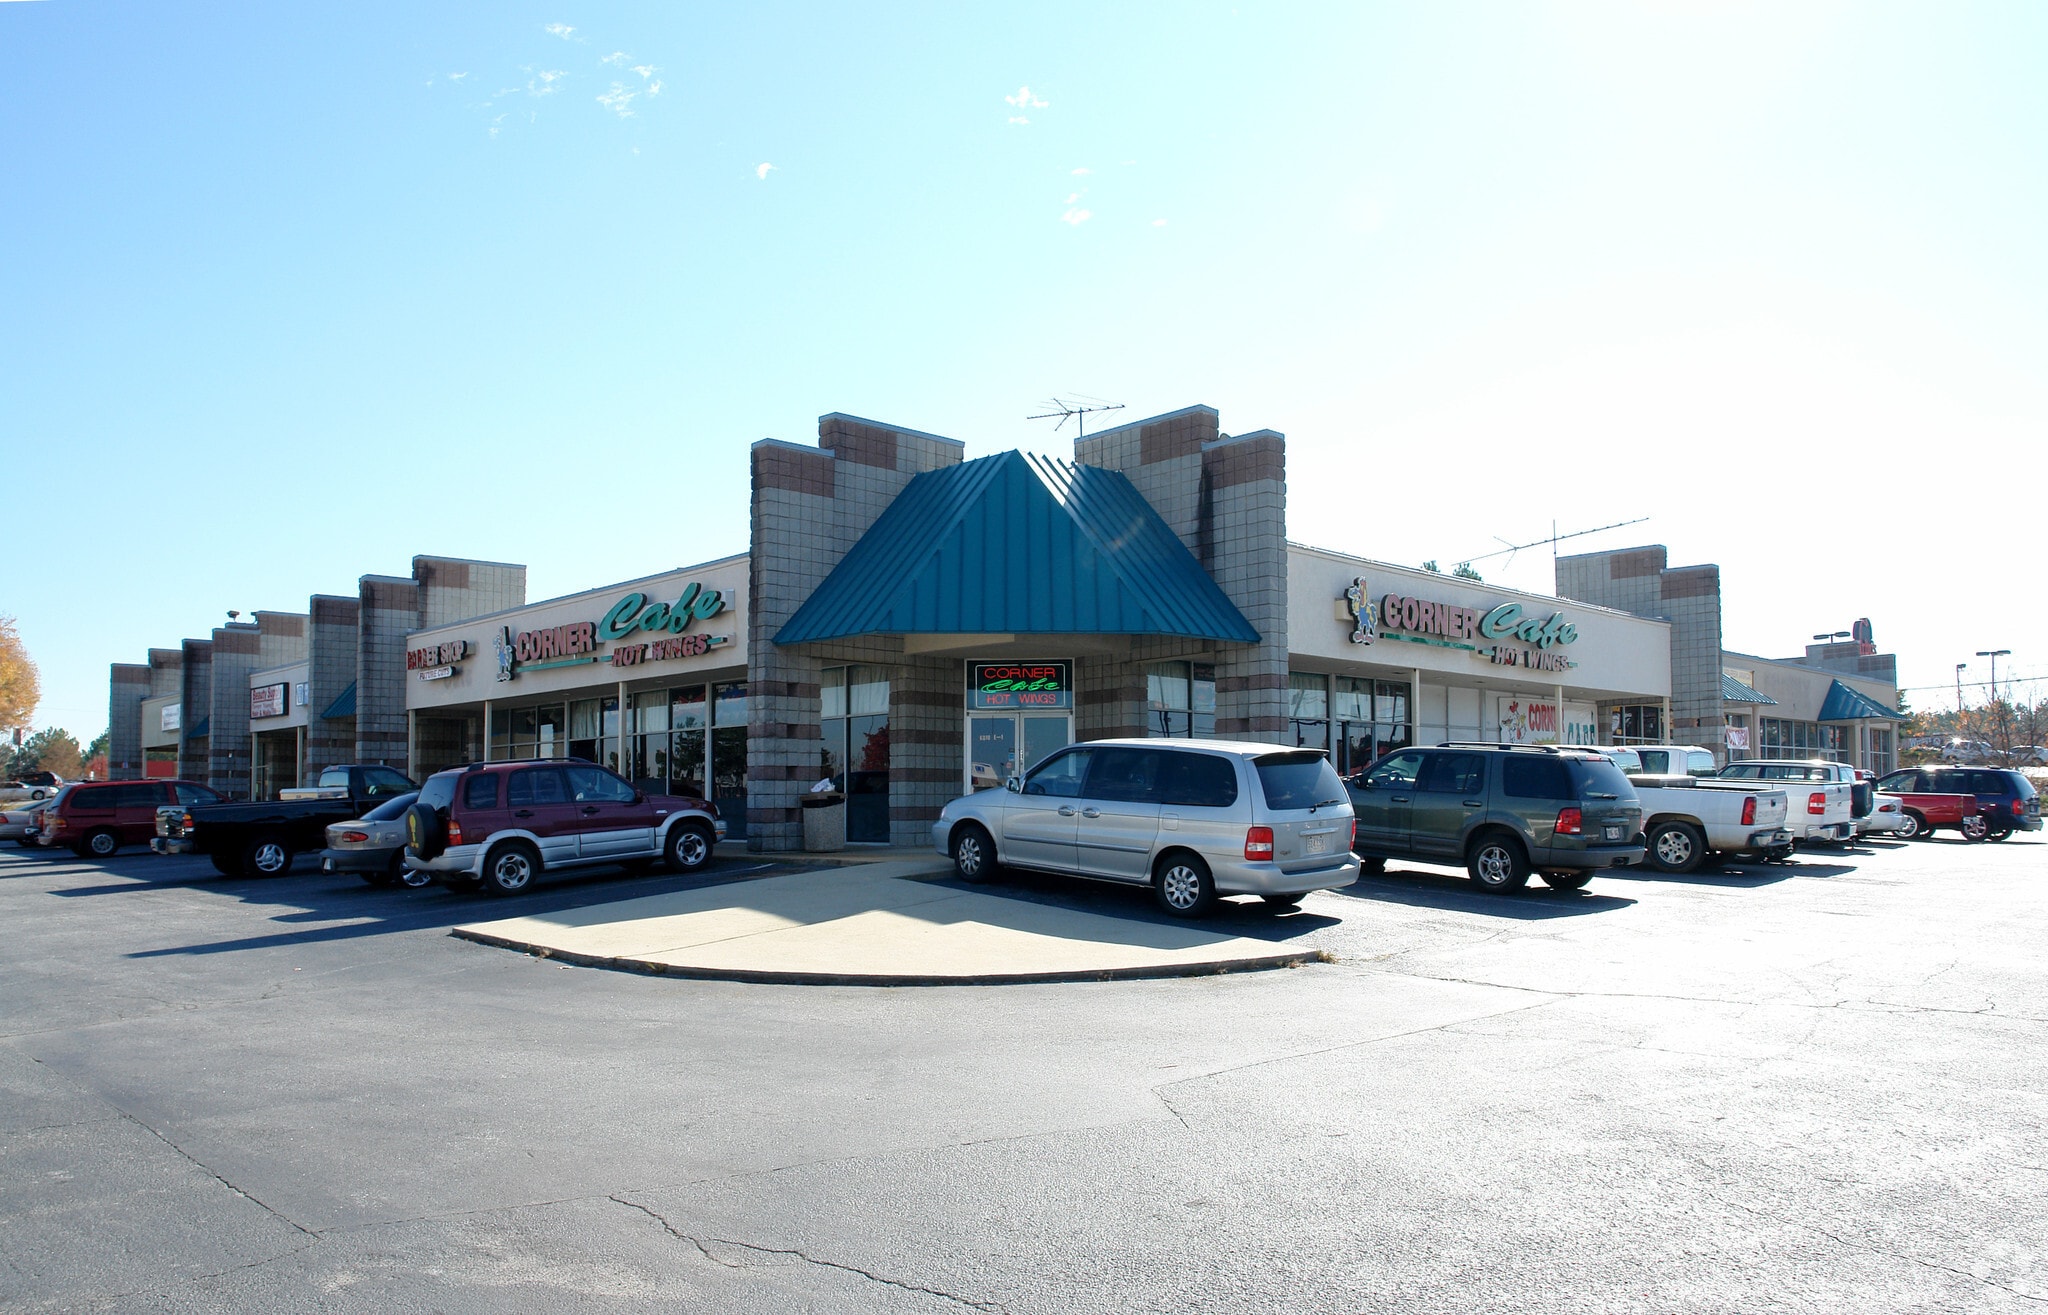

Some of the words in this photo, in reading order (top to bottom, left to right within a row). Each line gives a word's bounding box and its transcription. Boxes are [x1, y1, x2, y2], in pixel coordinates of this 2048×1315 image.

[515, 621, 597, 662] CORNER
[599, 582, 725, 641] Cafe
[1382, 593, 1477, 639] CORNER
[1479, 601, 1579, 650] Cafe
[440, 640, 465, 664] SHOP
[612, 643, 649, 667] HOT
[652, 633, 712, 661] WINGS
[1491, 646, 1523, 666] HOT
[1524, 651, 1568, 672] WINGS
[981, 678, 1060, 693] Cafe
[984, 667, 1056, 679] CORNER
[986, 694, 1011, 704] HOT
[1019, 694, 1056, 704] WINGS
